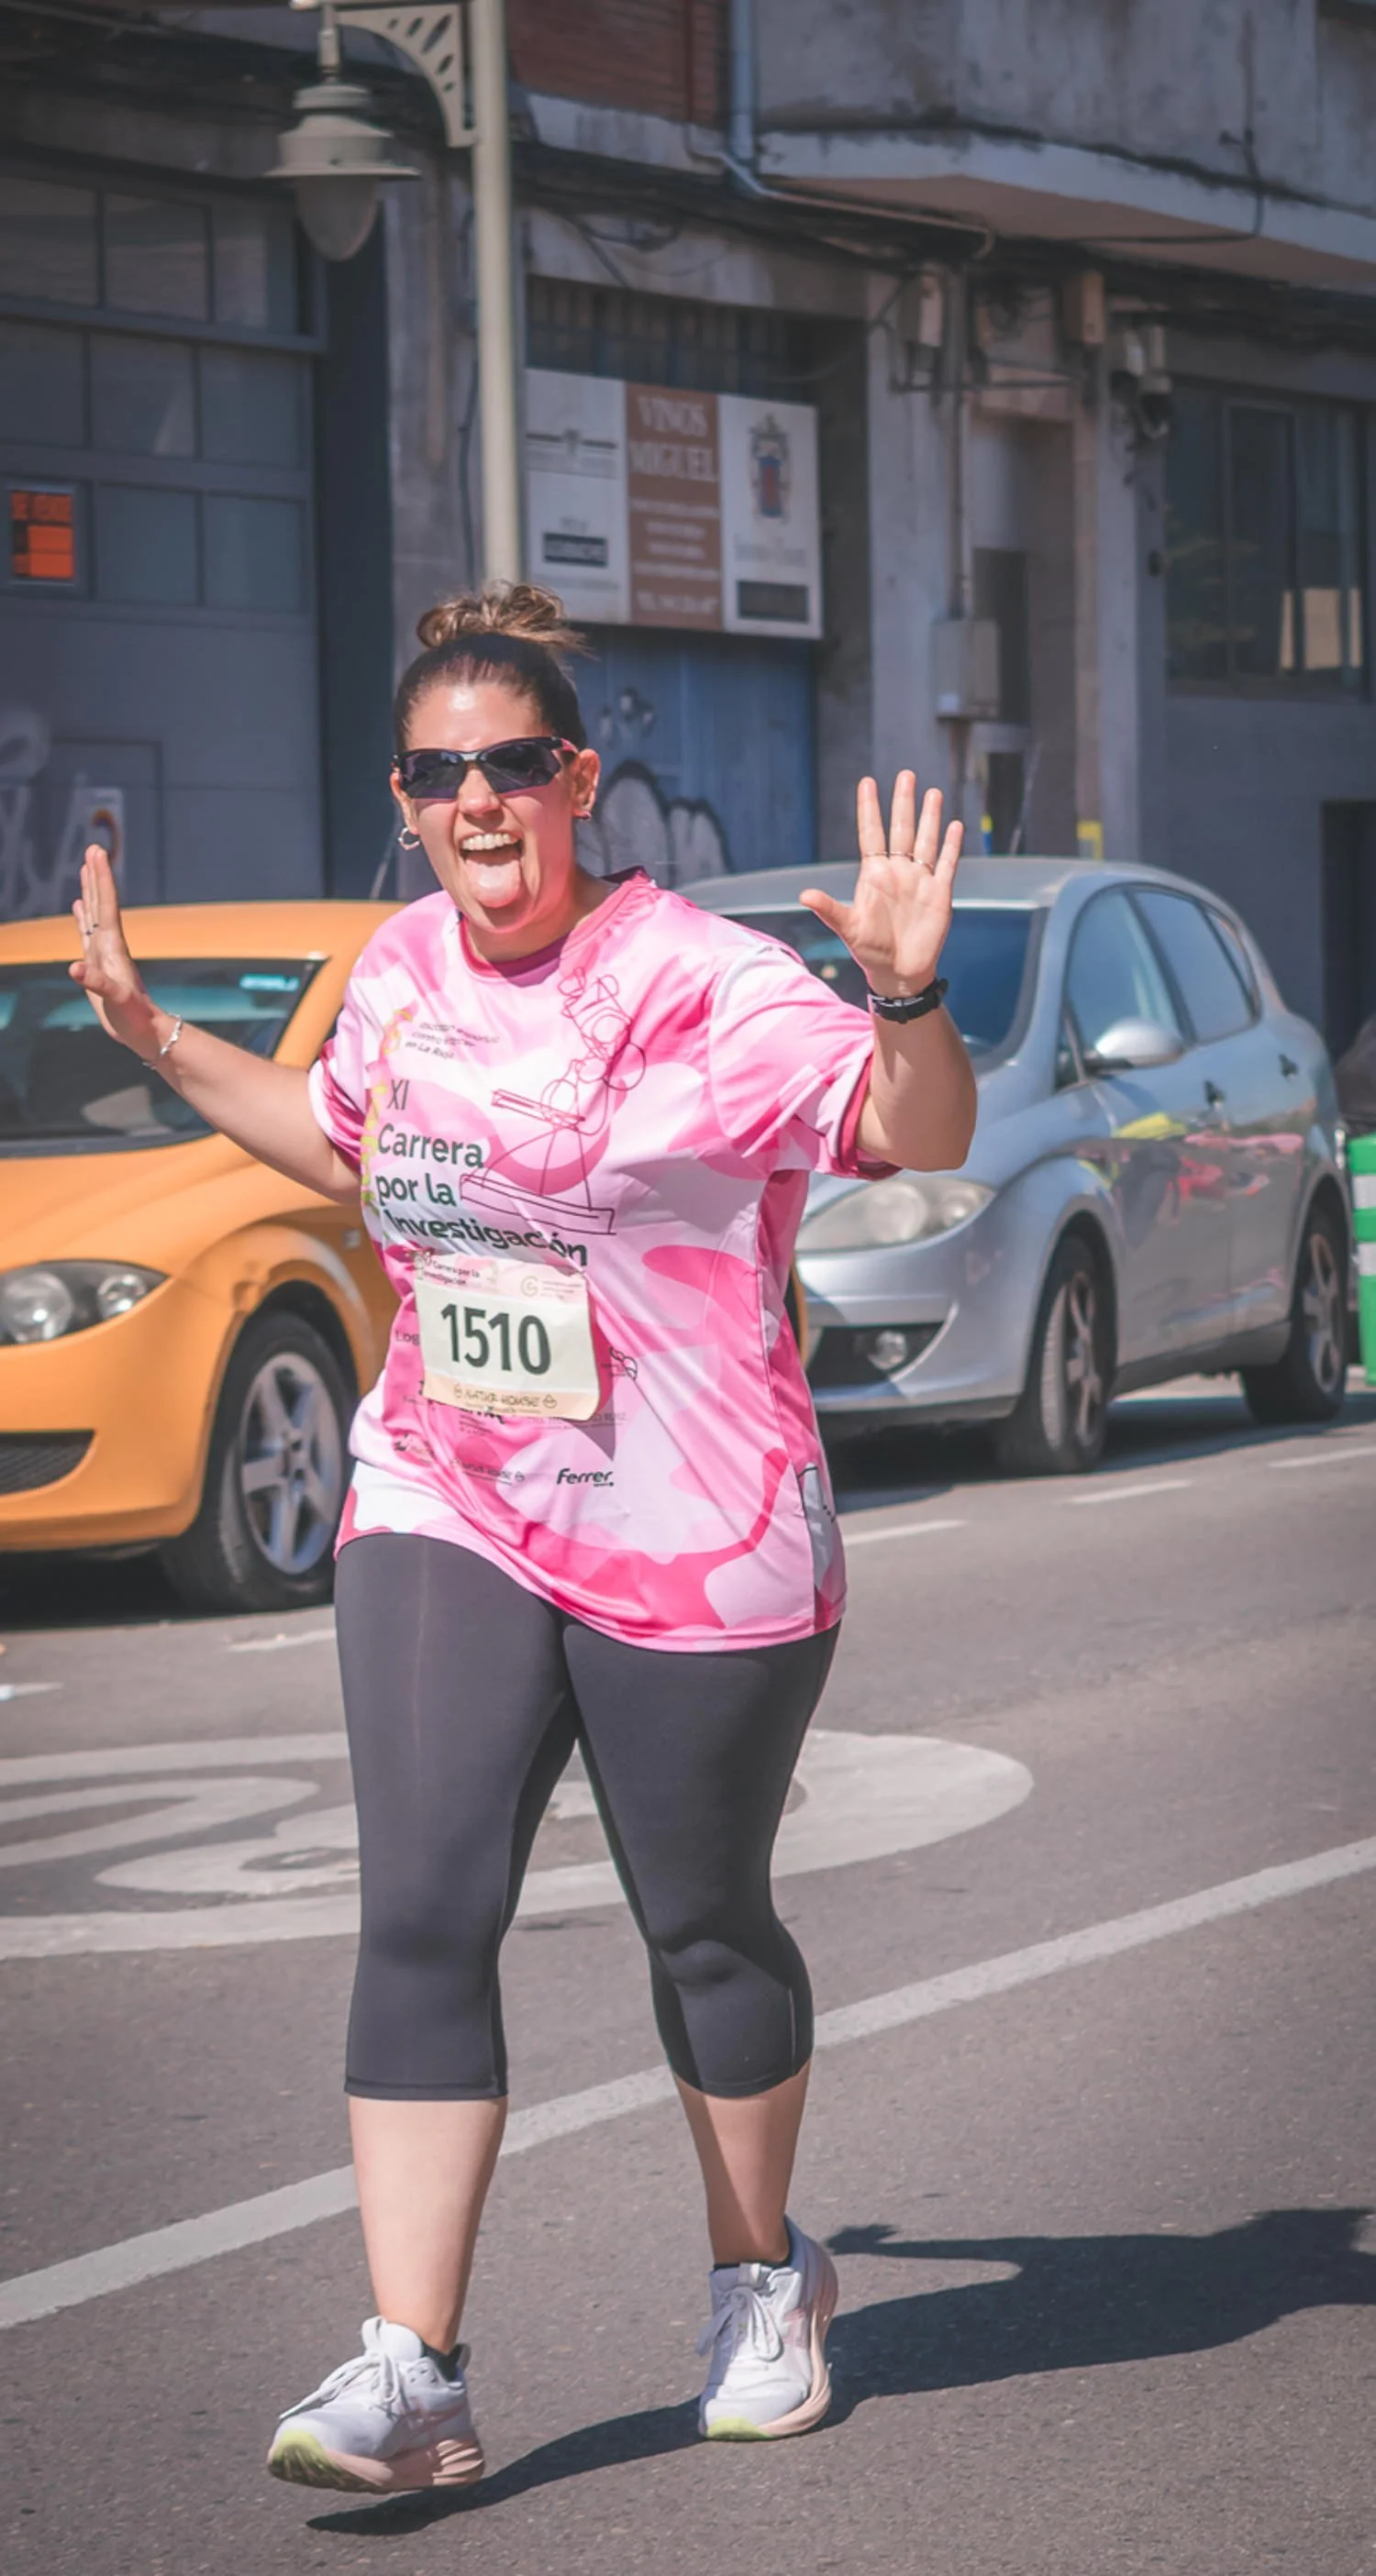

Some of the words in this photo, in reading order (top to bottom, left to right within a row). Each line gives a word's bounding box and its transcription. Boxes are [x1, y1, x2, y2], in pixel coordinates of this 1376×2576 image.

[387, 1079, 410, 1111] XI
[377, 1122, 484, 1169] Carrera
[376, 1174, 419, 1207] por
[425, 1172, 457, 1207] la
[383, 1209, 588, 1267] Investigacón
[440, 1302, 552, 1376] 1510
[556, 1467, 614, 1485] Ferrer
